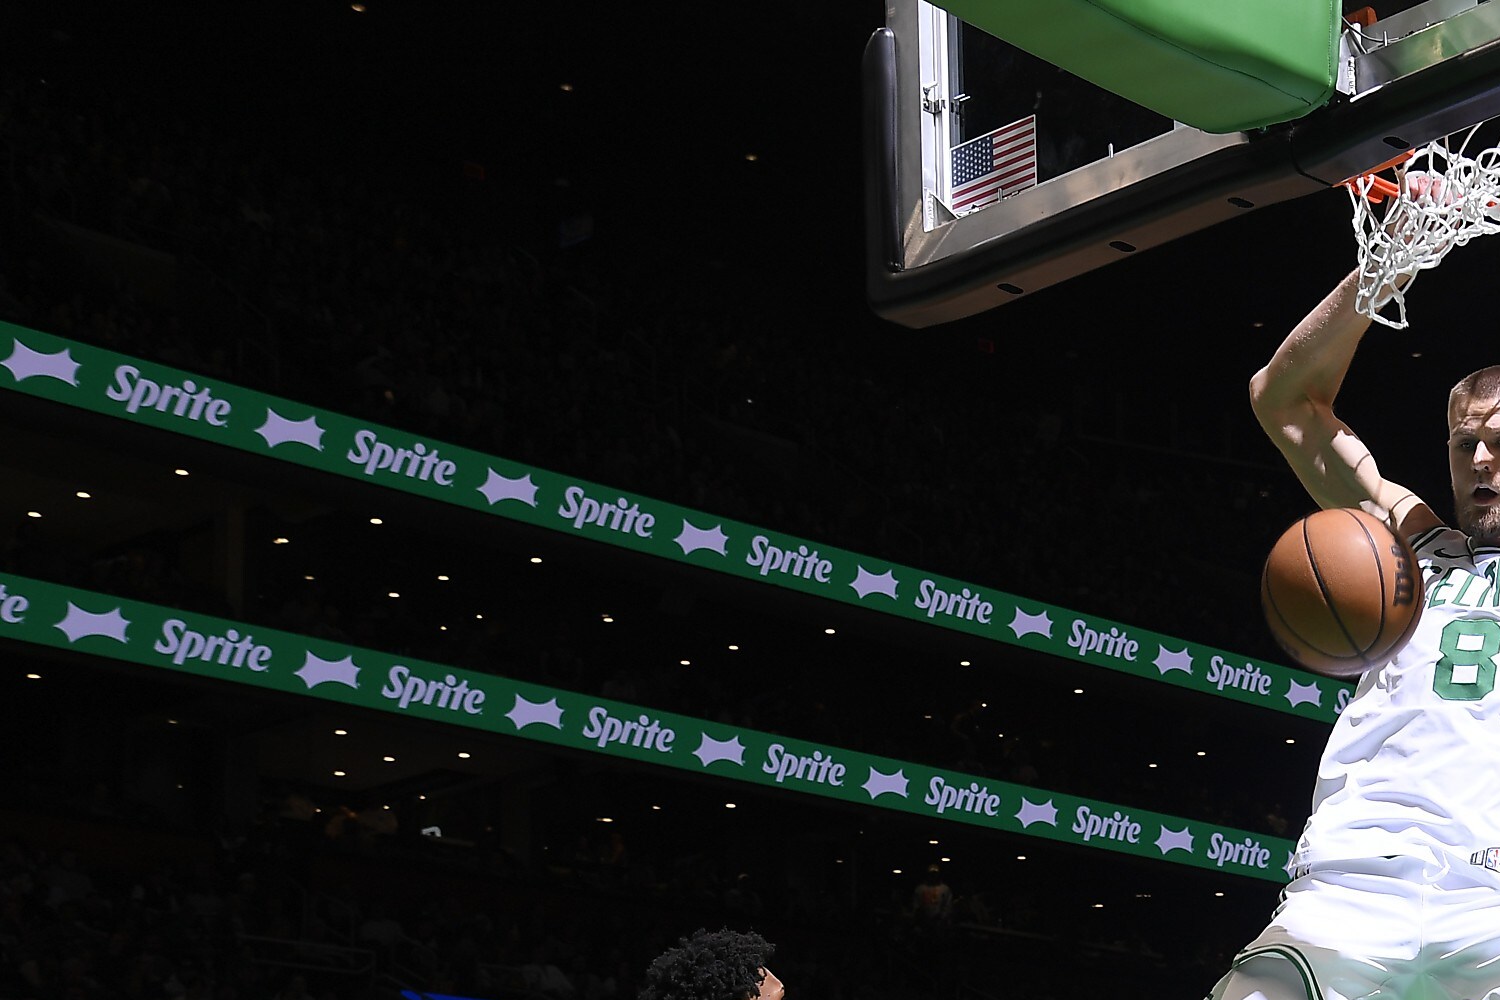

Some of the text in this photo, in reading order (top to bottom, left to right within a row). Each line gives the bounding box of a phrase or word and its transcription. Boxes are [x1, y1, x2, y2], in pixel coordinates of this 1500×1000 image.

[107, 365, 230, 428] Sprite
[347, 430, 457, 487] Sprite
[559, 486, 655, 538] Sprite
[746, 535, 833, 584] Sprite
[915, 579, 993, 625] Sprite
[154, 619, 272, 673] Sprite
[1067, 619, 1138, 661] Sprite
[382, 666, 486, 715] Sprite
[1206, 656, 1272, 695] Sprite
[583, 706, 676, 753] Sprite
[763, 743, 846, 787] Sprite
[925, 776, 1000, 817] Sprite
[1072, 805, 1141, 844] Sprite
[1206, 832, 1270, 869] Sprite
